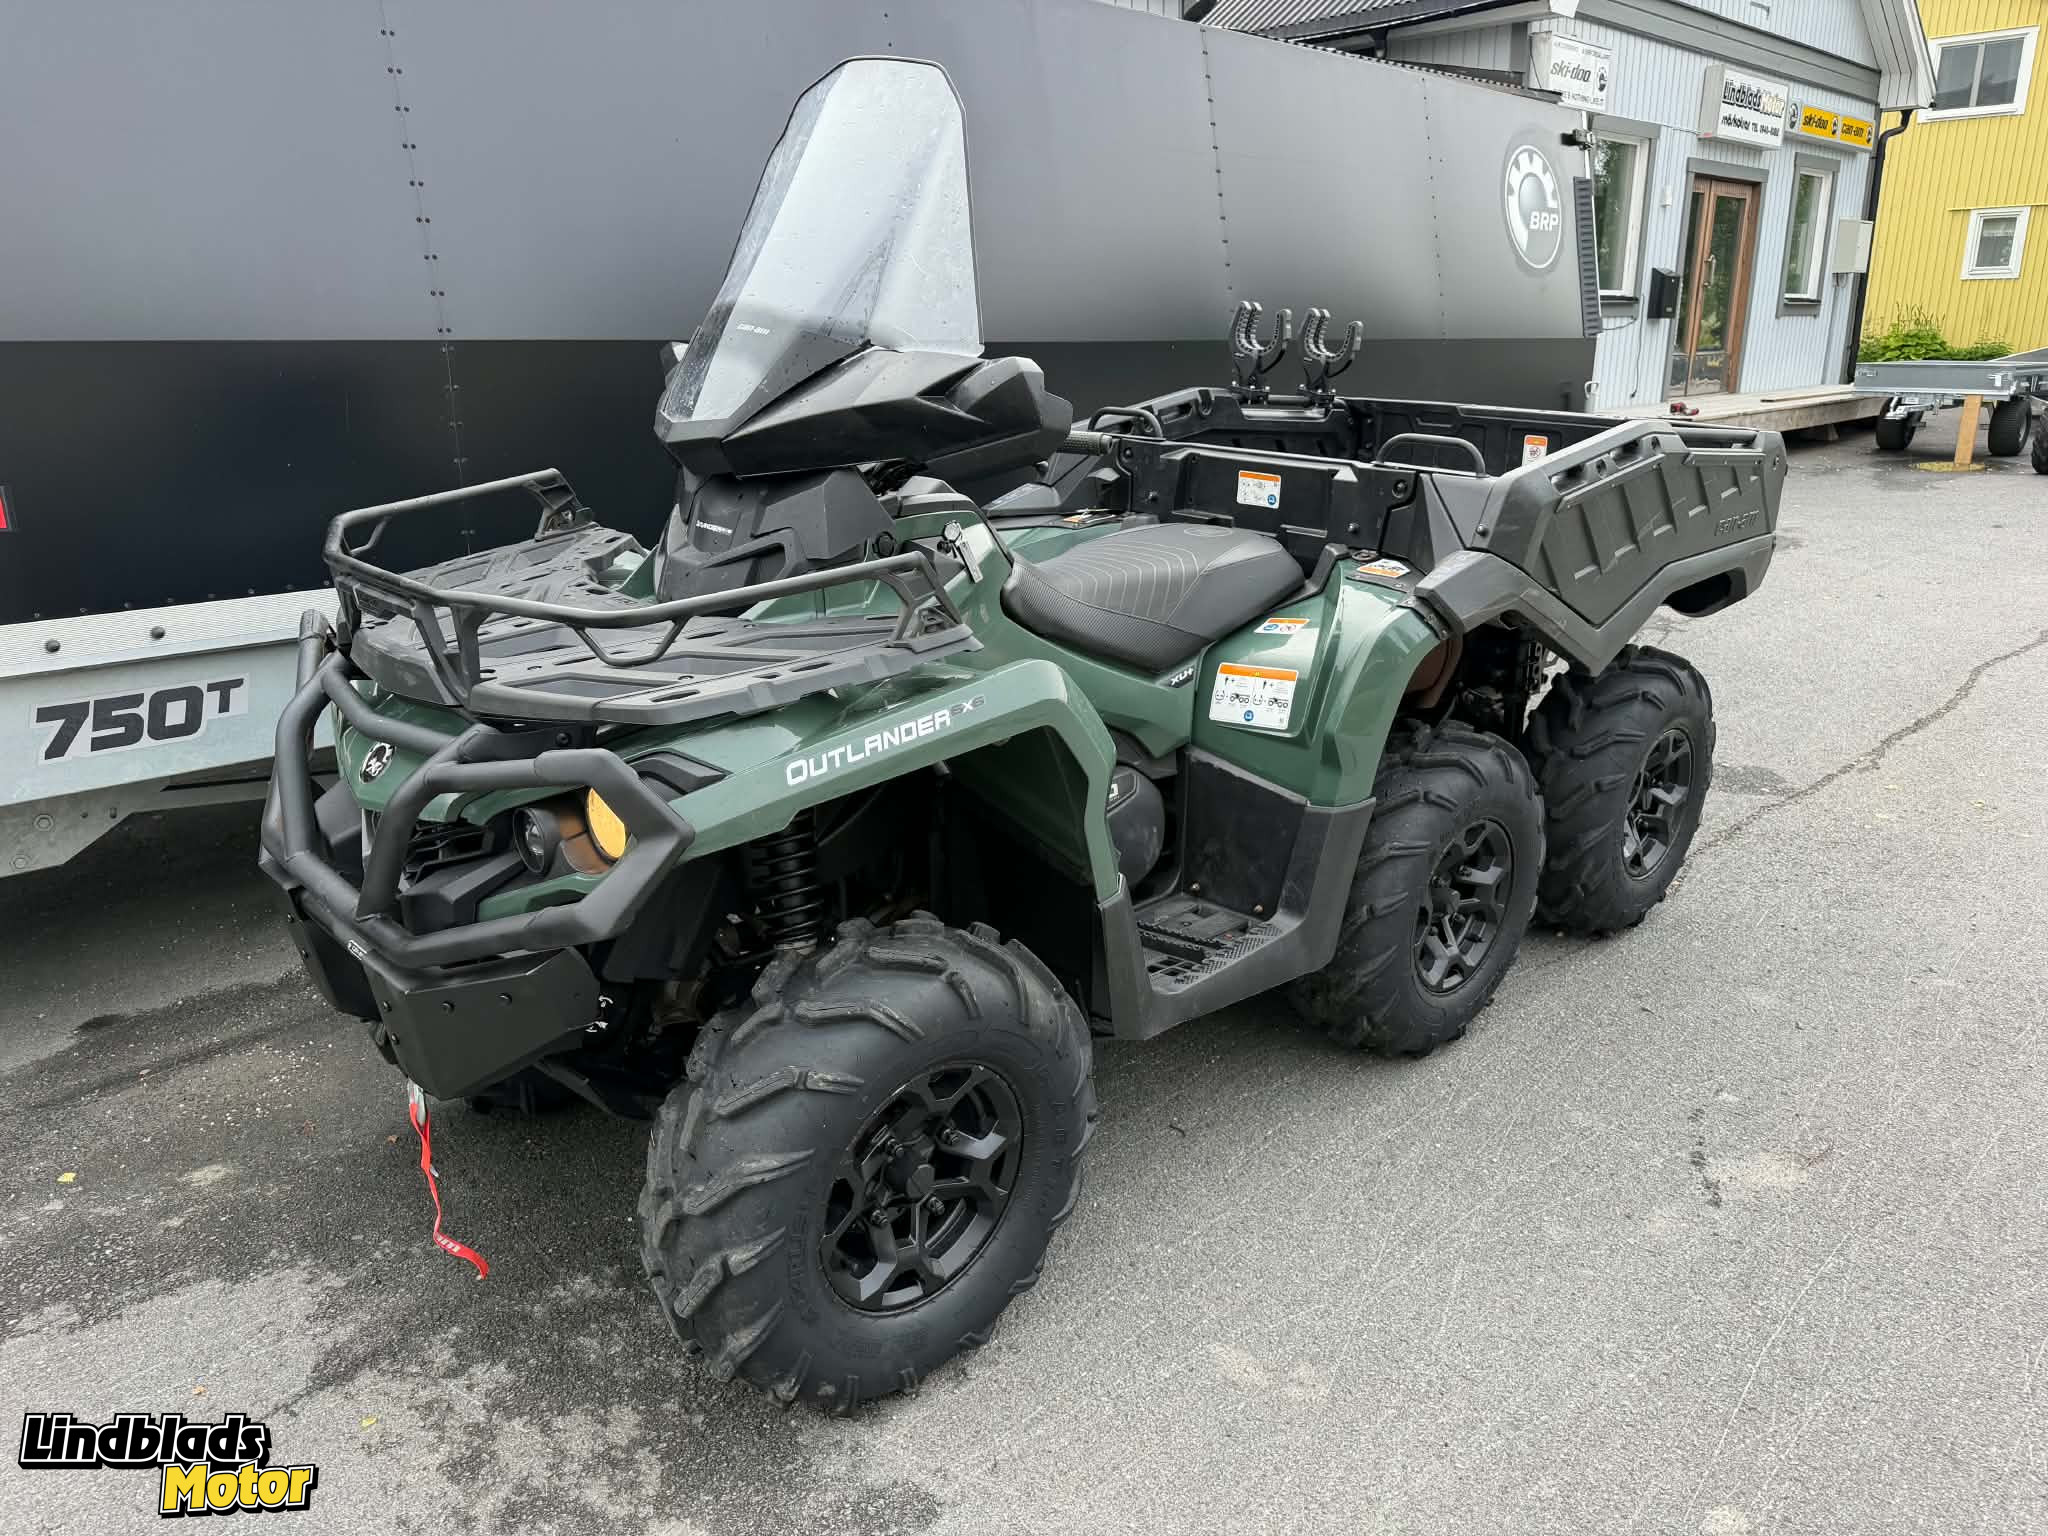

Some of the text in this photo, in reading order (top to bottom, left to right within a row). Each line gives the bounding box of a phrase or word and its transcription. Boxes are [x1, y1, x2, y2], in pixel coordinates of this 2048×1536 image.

[1550, 60, 1591, 82] ski-doo
[1723, 79, 1762, 108] Lindblads
[1803, 114, 1828, 130] ski-doo
[1529, 211, 1559, 231] BRP
[786, 709, 951, 787] OUTLANDER
